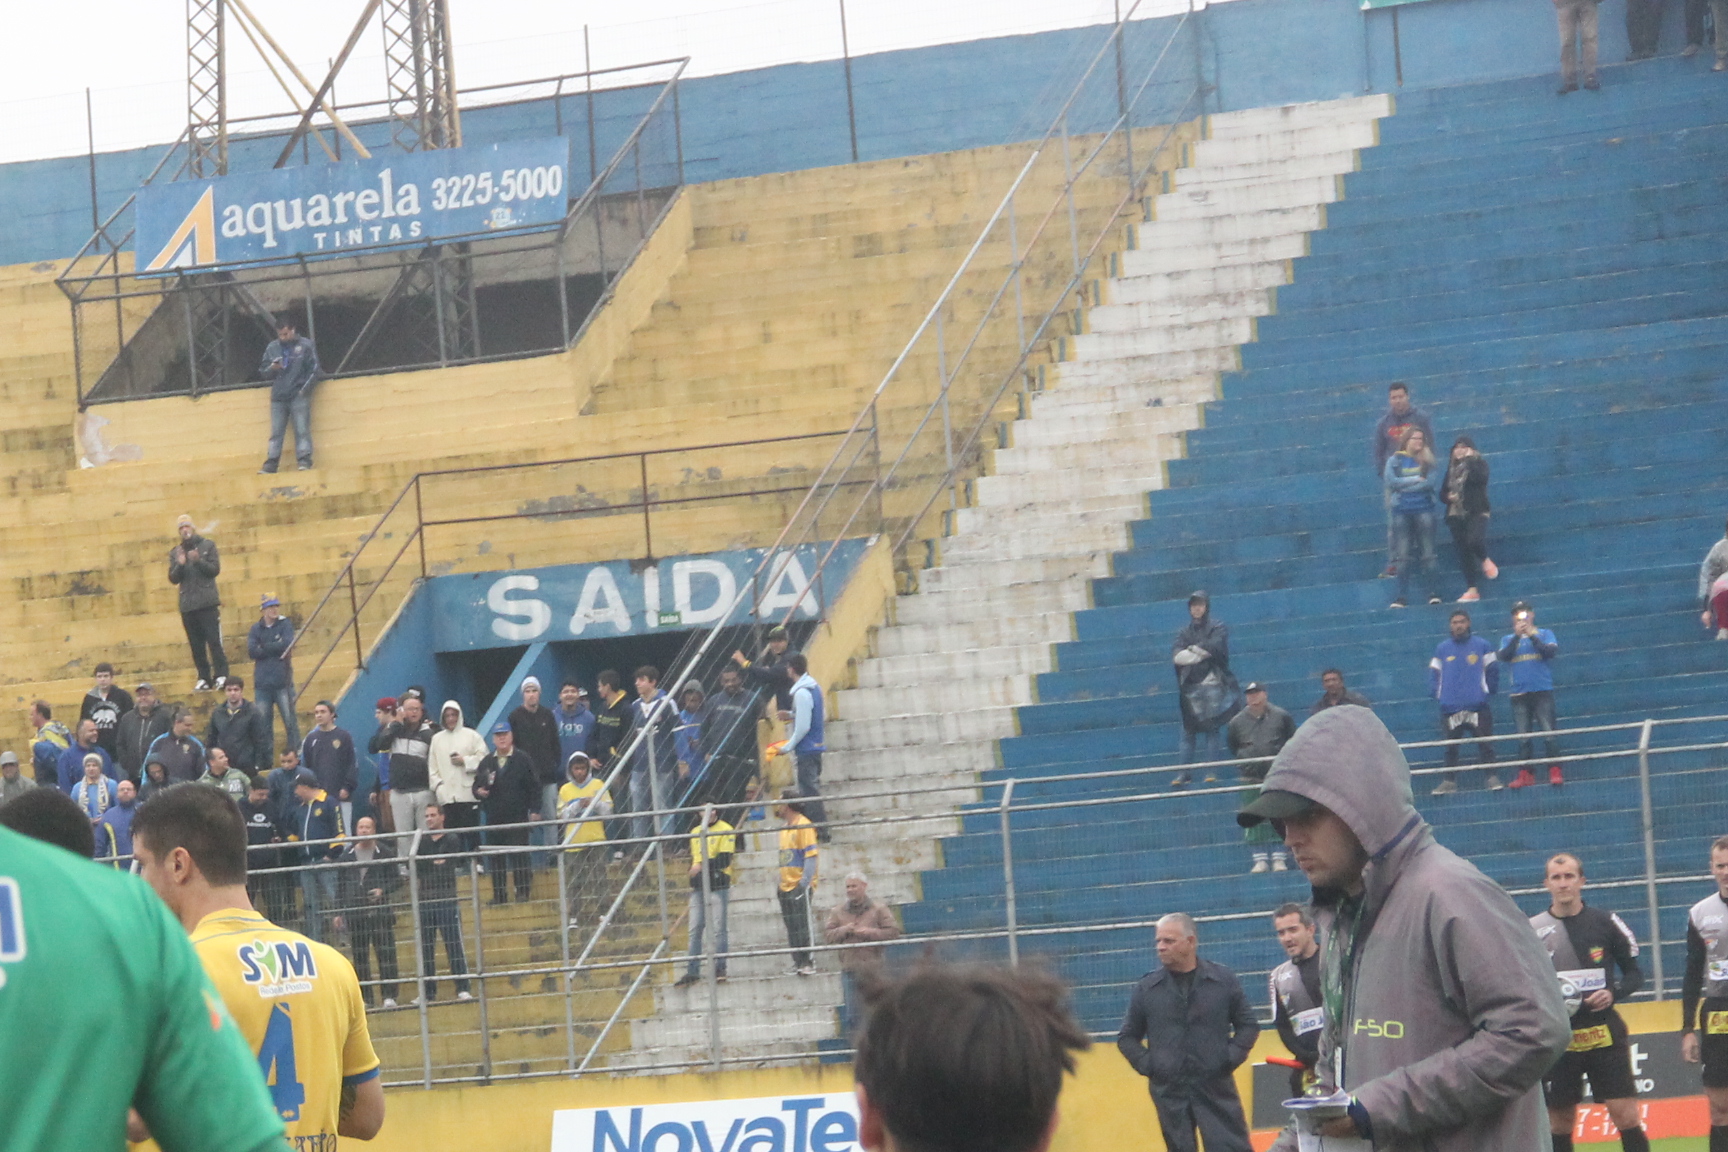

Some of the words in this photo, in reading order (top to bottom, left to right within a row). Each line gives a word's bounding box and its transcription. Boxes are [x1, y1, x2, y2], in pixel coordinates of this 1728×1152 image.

[221, 168, 421, 248] aquarela
[313, 220, 422, 250] TINTAS
[239, 940, 316, 983] SIM
[258, 1002, 306, 1122] 4
